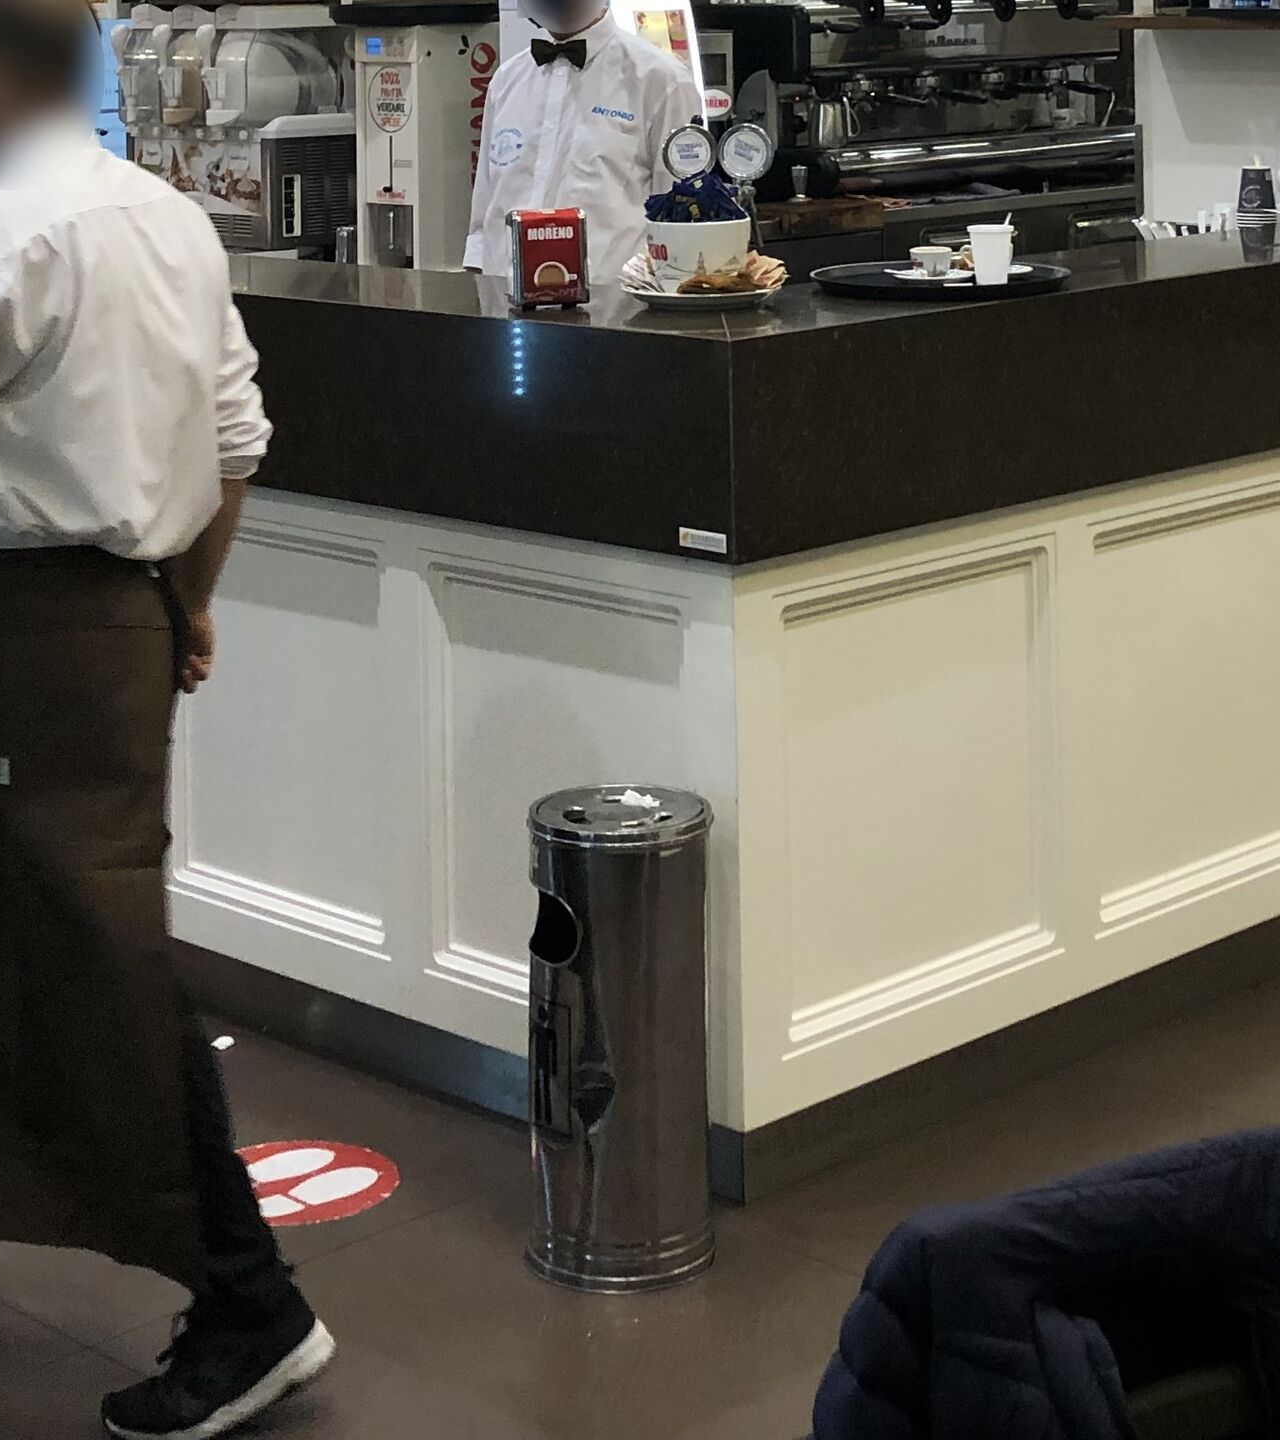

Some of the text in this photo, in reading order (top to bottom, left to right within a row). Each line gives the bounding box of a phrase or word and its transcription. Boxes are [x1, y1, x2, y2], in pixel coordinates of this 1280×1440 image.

[379, 71, 400, 86] 100%
[705, 98, 729, 109] RENO
[591, 105, 635, 122] ANTONIO
[527, 226, 574, 241] MORENO
